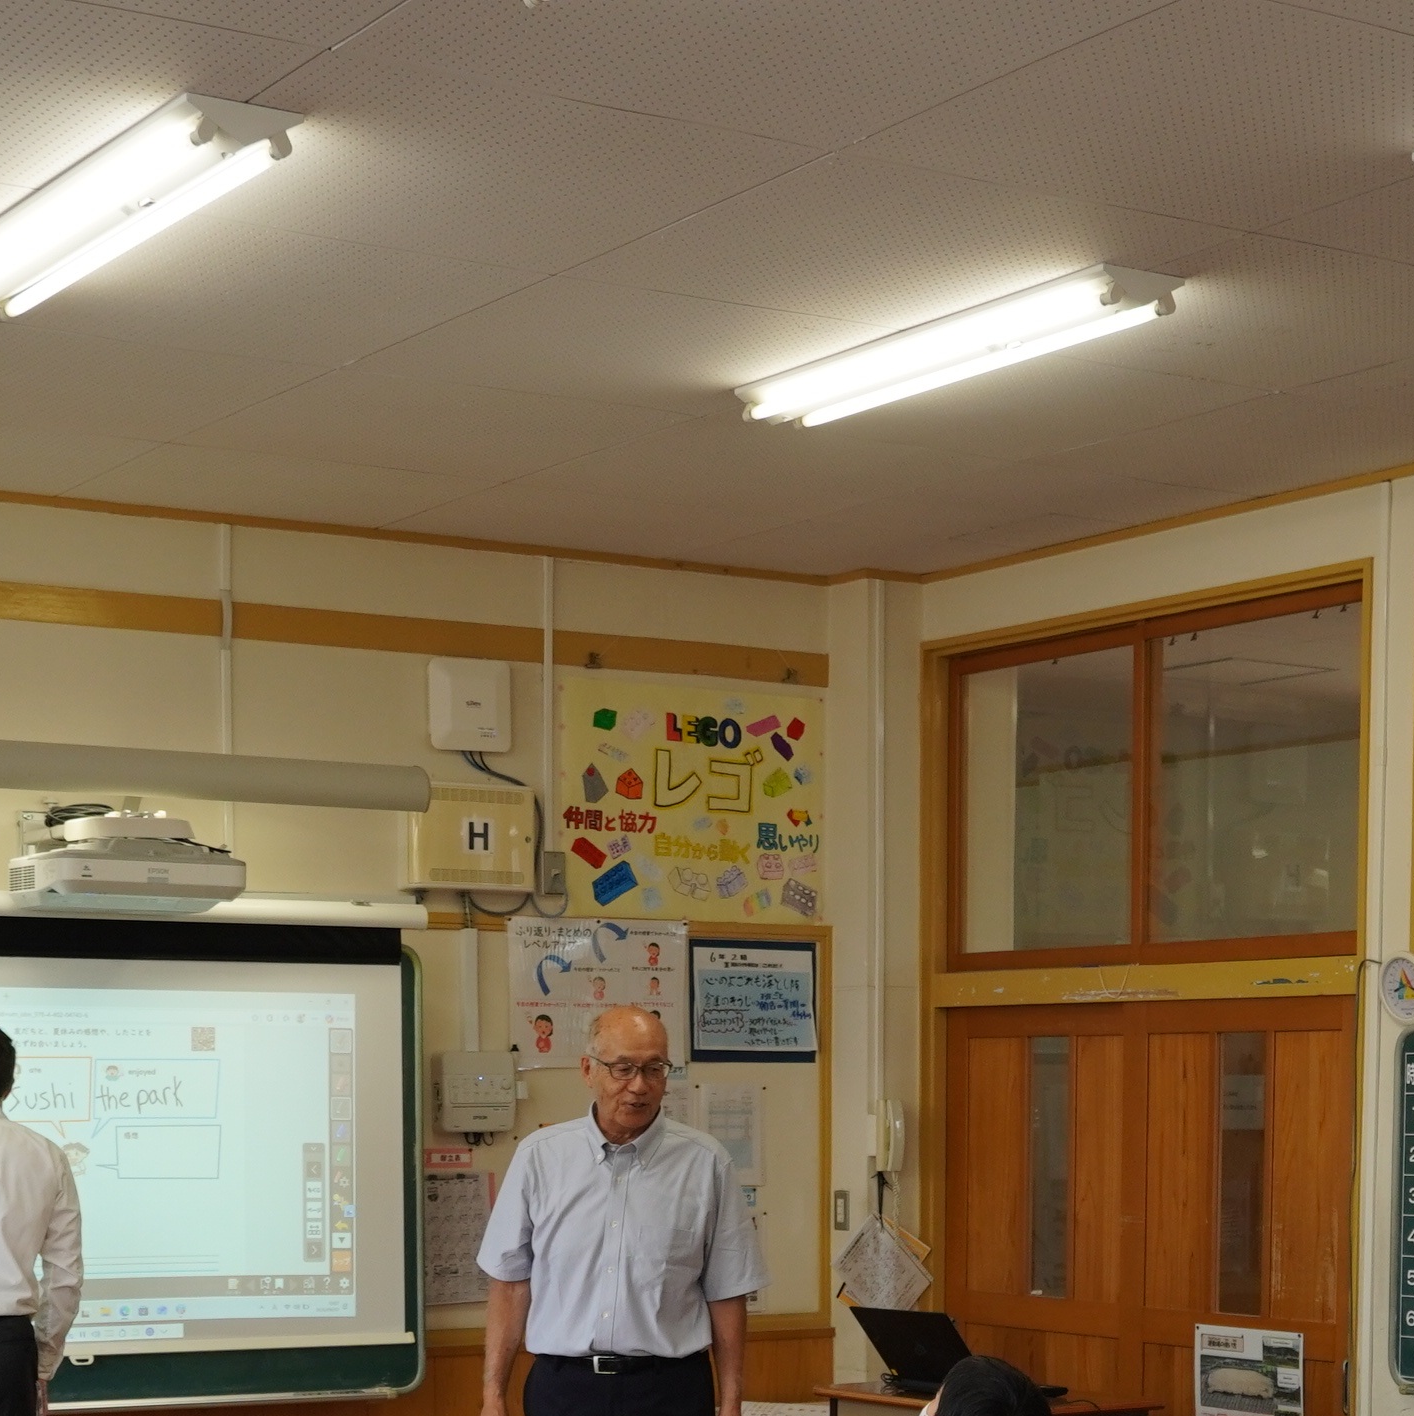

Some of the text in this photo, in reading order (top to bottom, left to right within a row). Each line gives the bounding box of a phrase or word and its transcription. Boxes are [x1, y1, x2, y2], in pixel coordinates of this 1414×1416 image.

[665, 711, 742, 749] LEGO
[653, 747, 764, 814] レゴ
[467, 820, 490, 852] H
[562, 805, 658, 835] 仲間と協力
[653, 831, 751, 865] 自分から動く
[755, 822, 820, 854] 思いやり
[147, 867, 170, 875] EPSON
[127, 1068, 157, 1077] enjoyed
[136, 1076, 184, 1114] park
